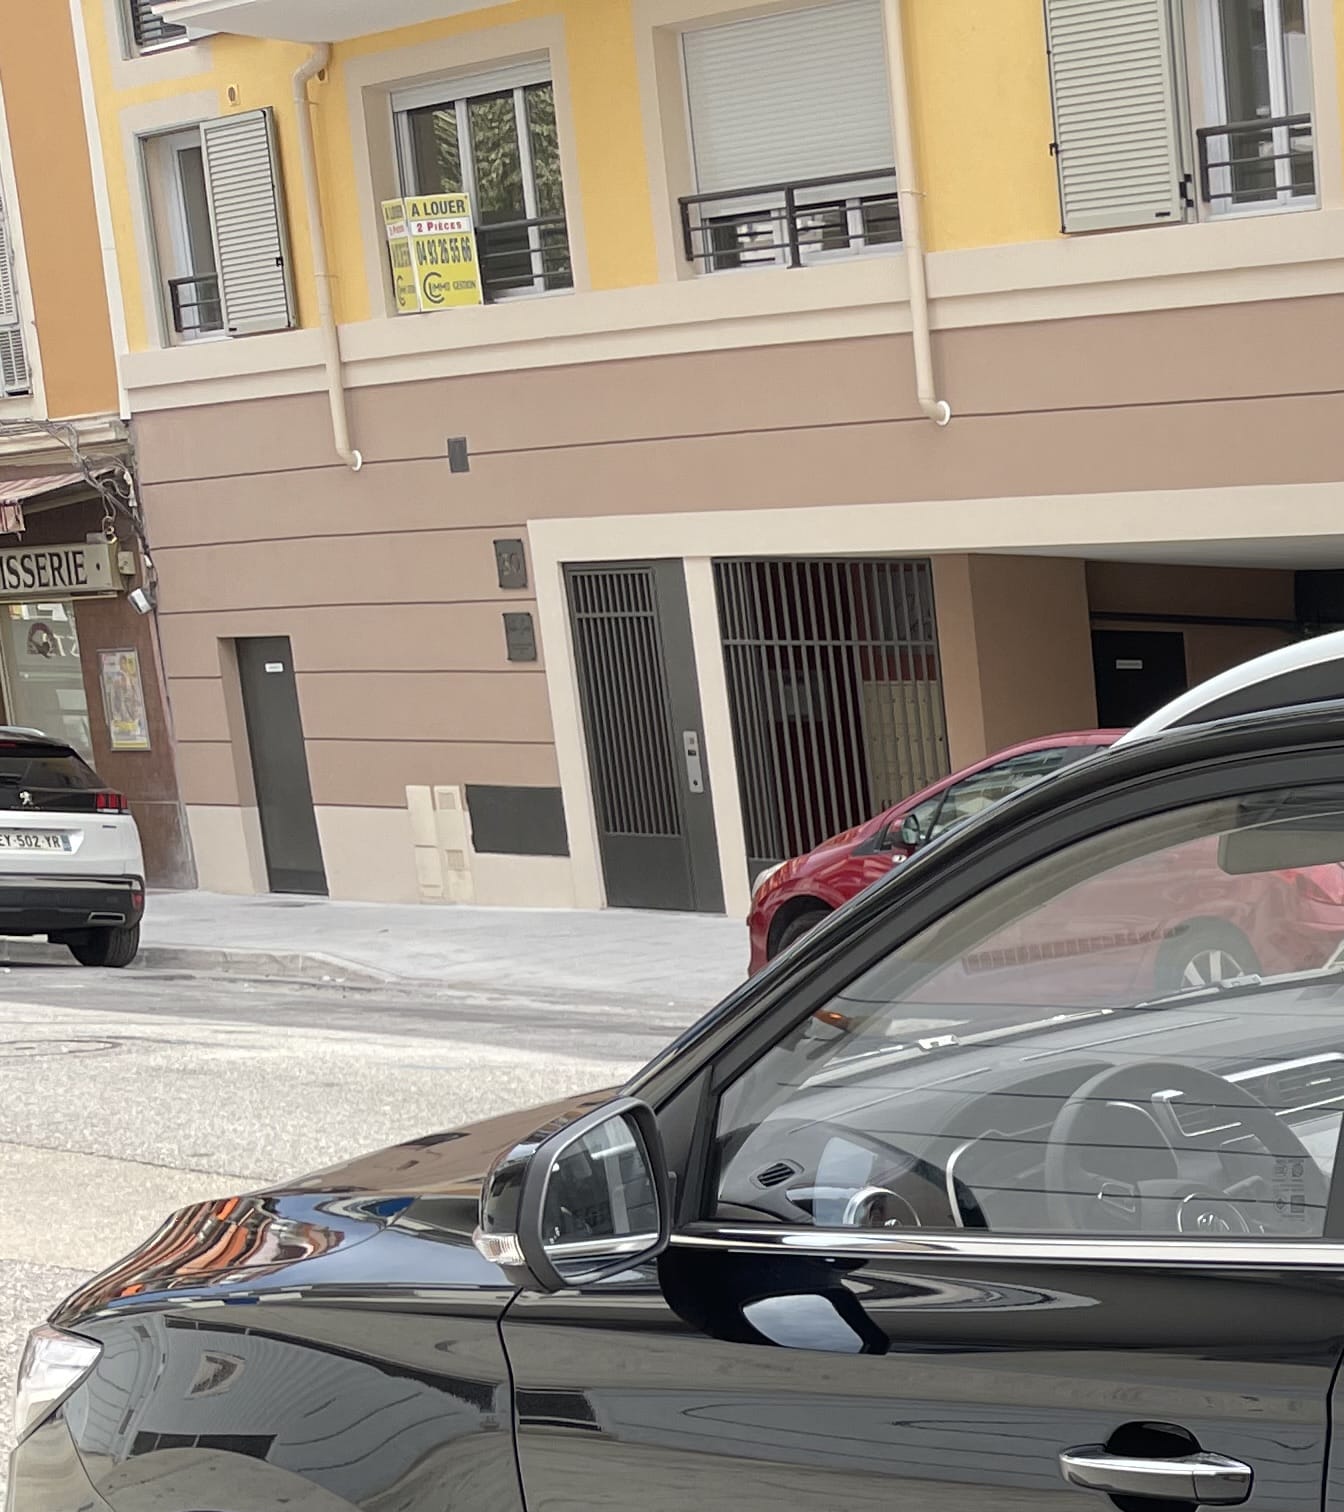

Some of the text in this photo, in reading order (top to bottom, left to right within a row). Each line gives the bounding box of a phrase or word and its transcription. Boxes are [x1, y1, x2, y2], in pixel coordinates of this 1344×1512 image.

[411, 203, 420, 217] A
[424, 199, 466, 215] LOUER
[416, 223, 423, 232] 2
